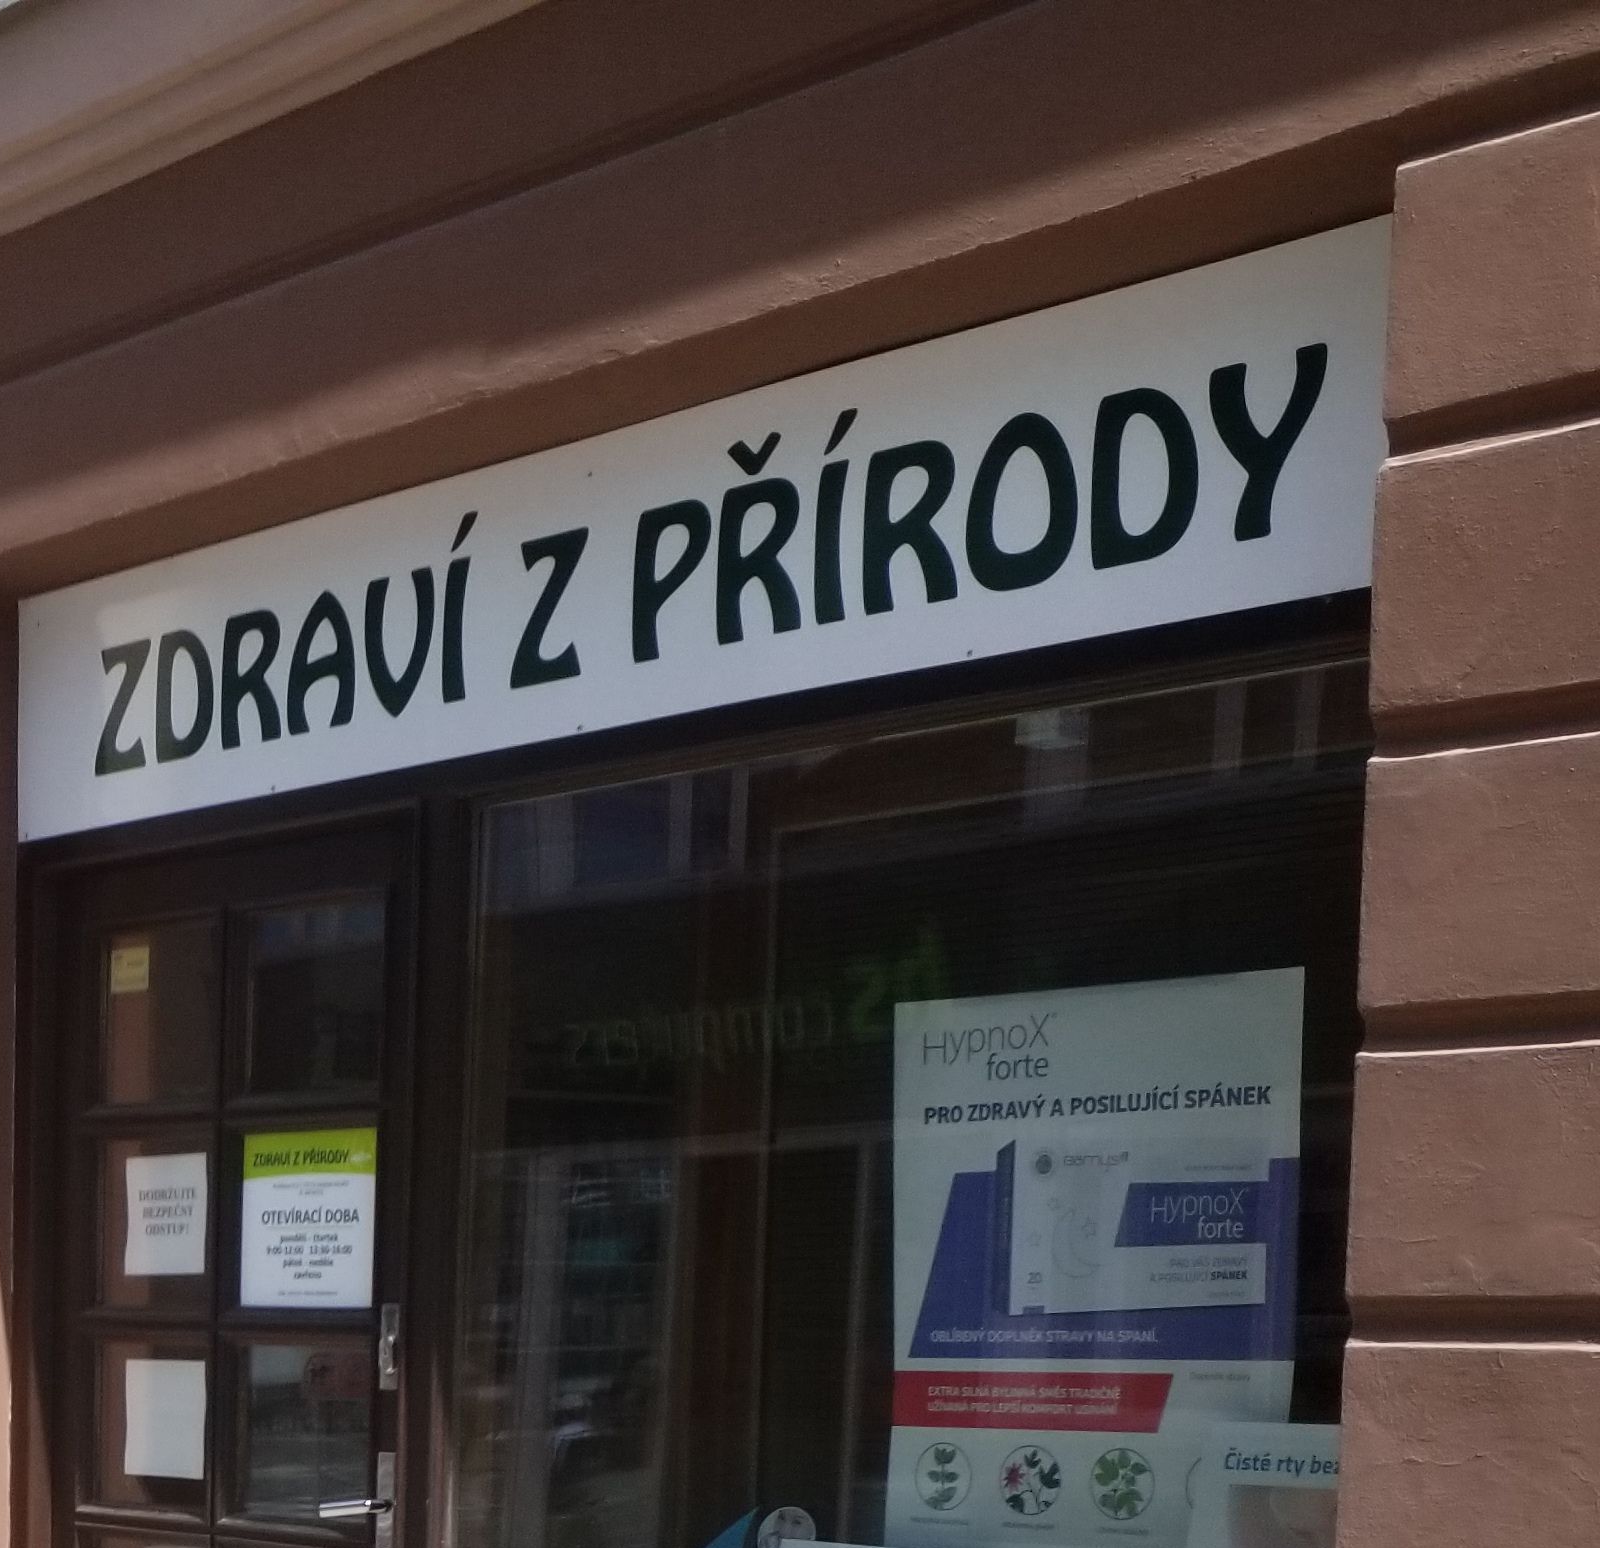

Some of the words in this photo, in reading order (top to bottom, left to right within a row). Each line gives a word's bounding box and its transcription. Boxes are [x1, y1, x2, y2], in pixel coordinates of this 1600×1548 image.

[94, 511, 478, 777] ZDRAVÍ
[510, 526, 590, 689] Z
[631, 342, 1329, 664] PŘÍRODY
[922, 1012, 1050, 1066] HypnoX
[986, 1052, 1049, 1081] forte
[923, 1104, 963, 1125] PRO
[967, 1093, 1045, 1122] ZDRAVÝ
[1049, 1101, 1065, 1117] A
[1069, 1084, 1179, 1115] POSILUJÍCÍ
[1183, 1081, 1272, 1110] SPÁNEK
[262, 1206, 322, 1226] OTEVÍRACÍ
[325, 1208, 361, 1224] DOBA
[1197, 1216, 1244, 1239] forte
[1224, 1447, 1272, 1472] Čisté
[1277, 1456, 1306, 1478] rty
